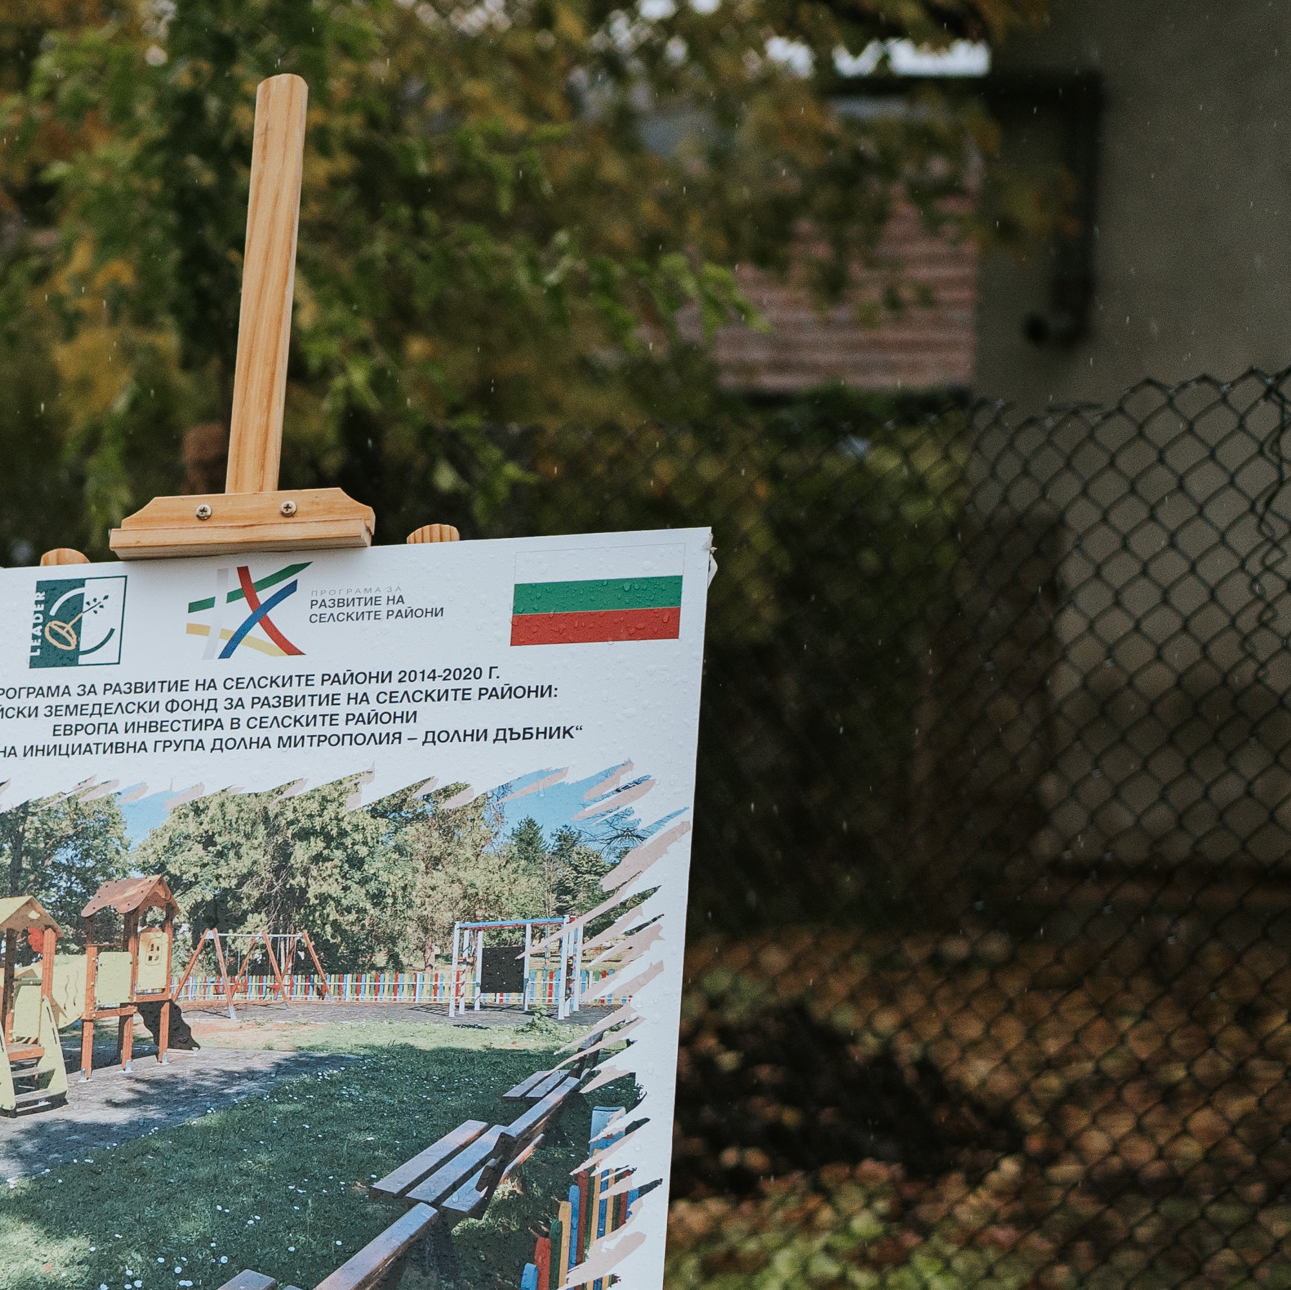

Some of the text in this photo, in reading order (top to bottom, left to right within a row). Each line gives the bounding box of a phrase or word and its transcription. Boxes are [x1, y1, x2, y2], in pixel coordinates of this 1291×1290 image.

[310, 595, 405, 609] РАЗВИТИЕ НА
[311, 585, 402, 597] ПРОГРАМА ЗА
[29, 591, 46, 656] LEADER
[309, 606, 444, 624] СЕЛСКИТЕ РАЙОНИ
[77, 684, 98, 697] ЗА
[103, 679, 190, 696] РАЗВИТИЕ
[195, 678, 218, 691] НА
[223, 673, 315, 690] СЕЛСКИТЕ
[320, 669, 393, 687] РАЙОНИ
[397, 667, 483, 683] 2014-2020
[43, 700, 160, 718] ЗЕМЕДЕЛСКИ
[164, 698, 218, 715] ФОНД
[223, 697, 246, 711] ЗА
[250, 692, 341, 709] РАЗВИТИЕ
[347, 691, 371, 706] НА
[375, 688, 472, 705] СЕЛСКИТЕ
[477, 683, 558, 701] РАЙОНИ:
[52, 708, 418, 737] ЕВРОПА ИНВЕСТИРА В СЕЛСКИТЕ РАЙОНИ
[23, 740, 148, 759] ИНИЦИАТИВНА
[153, 738, 206, 753] ГРУПА
[210, 734, 272, 751] ДОЛНА
[277, 732, 402, 749] МИТРОПОЛИЯ
[422, 728, 488, 747] ДОЛНИ
